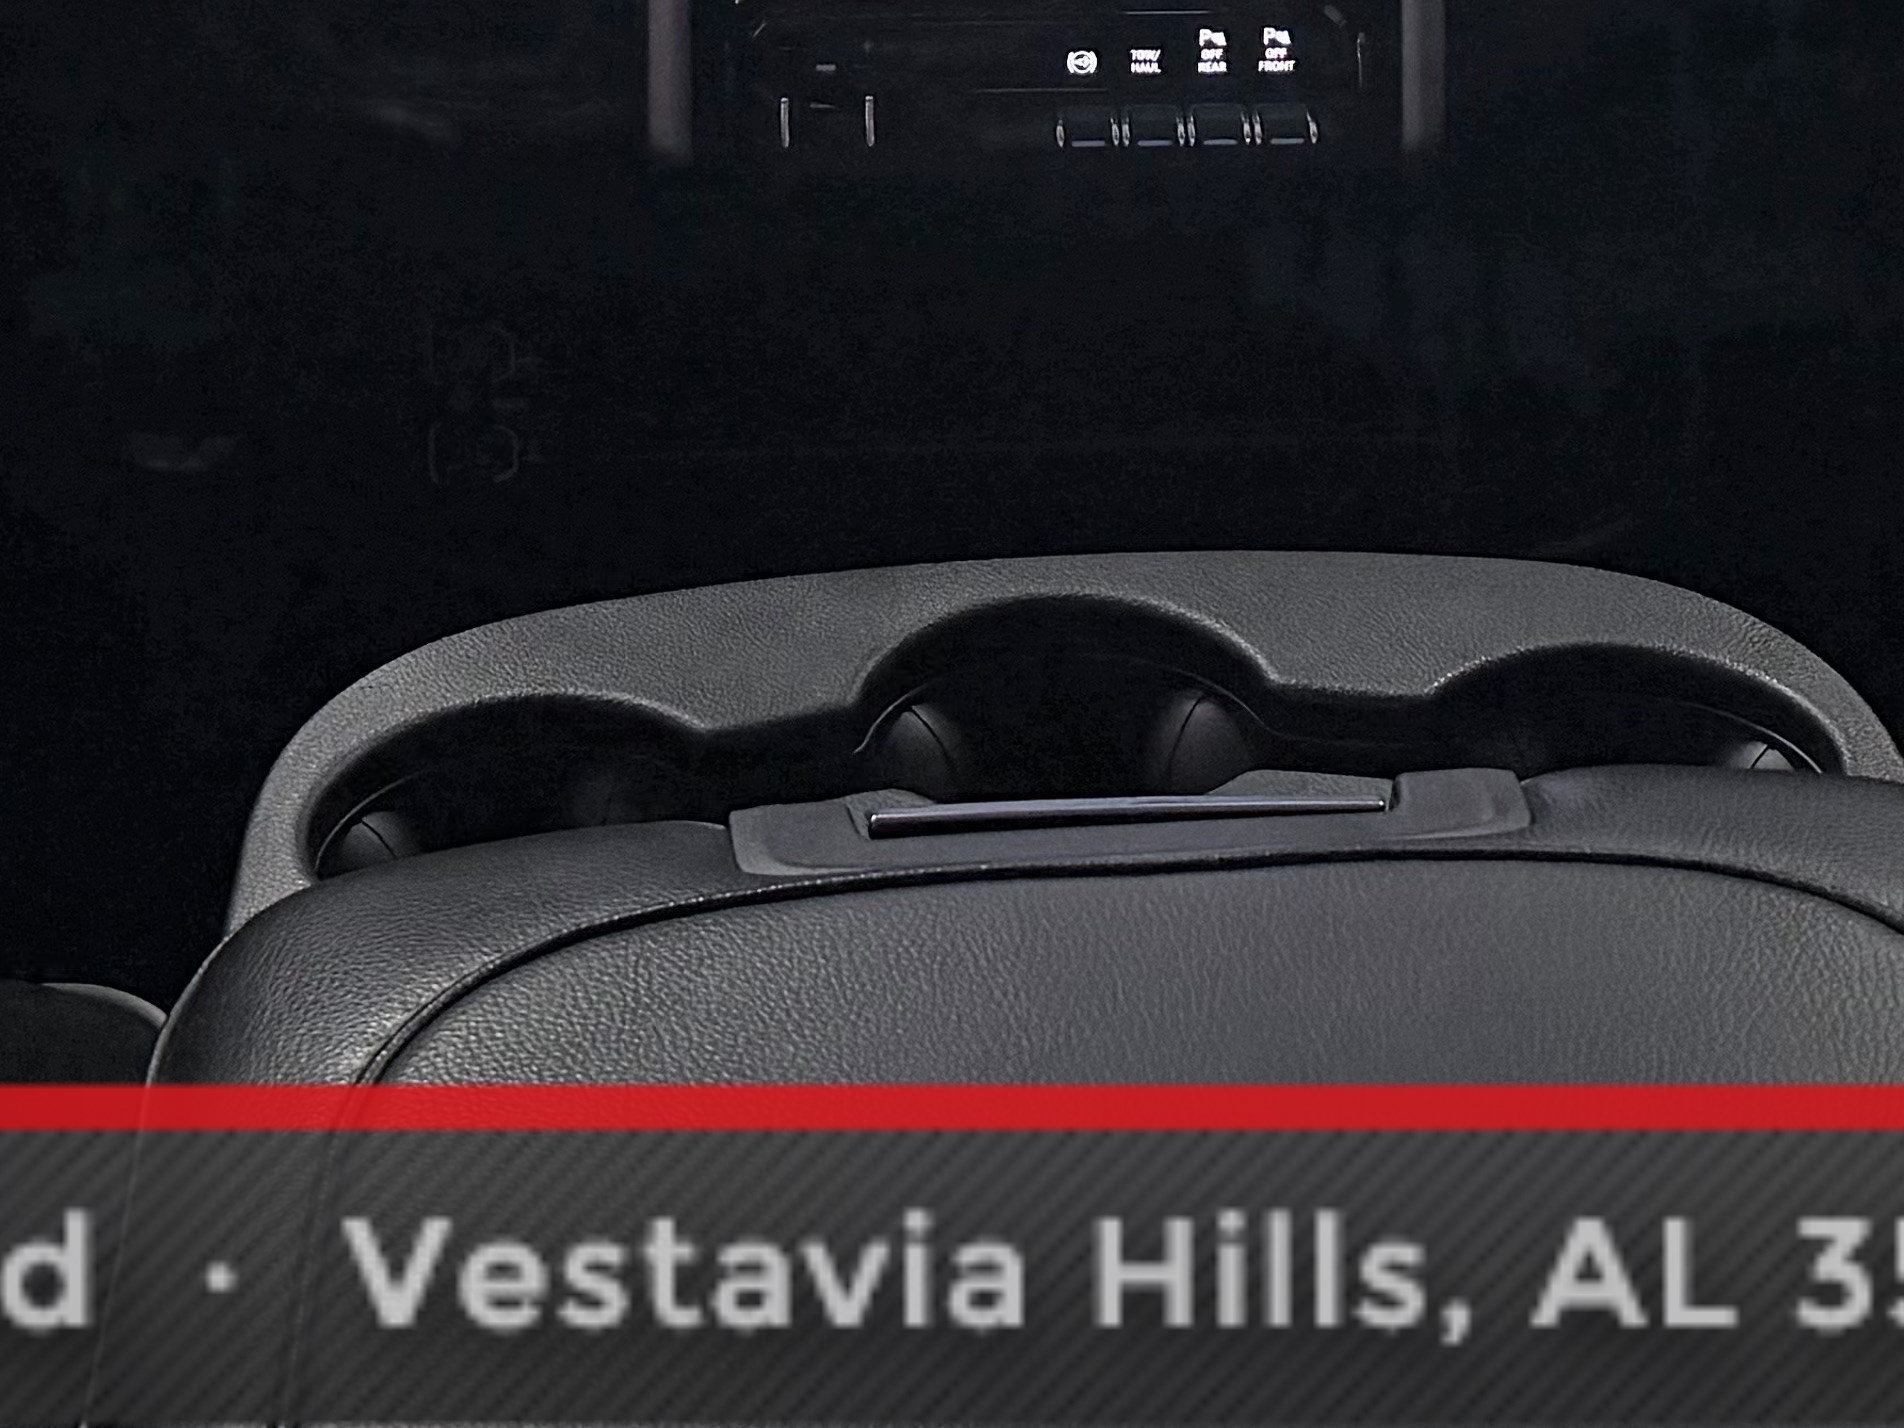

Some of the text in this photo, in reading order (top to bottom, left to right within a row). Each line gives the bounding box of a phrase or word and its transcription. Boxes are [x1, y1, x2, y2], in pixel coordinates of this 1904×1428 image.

[1200, 48, 1224, 60] OFF
[1265, 47, 1288, 59] OFF
[1130, 62, 1162, 74] HAUL
[1197, 60, 1228, 73] REAR
[1258, 59, 1296, 72] FRONT
